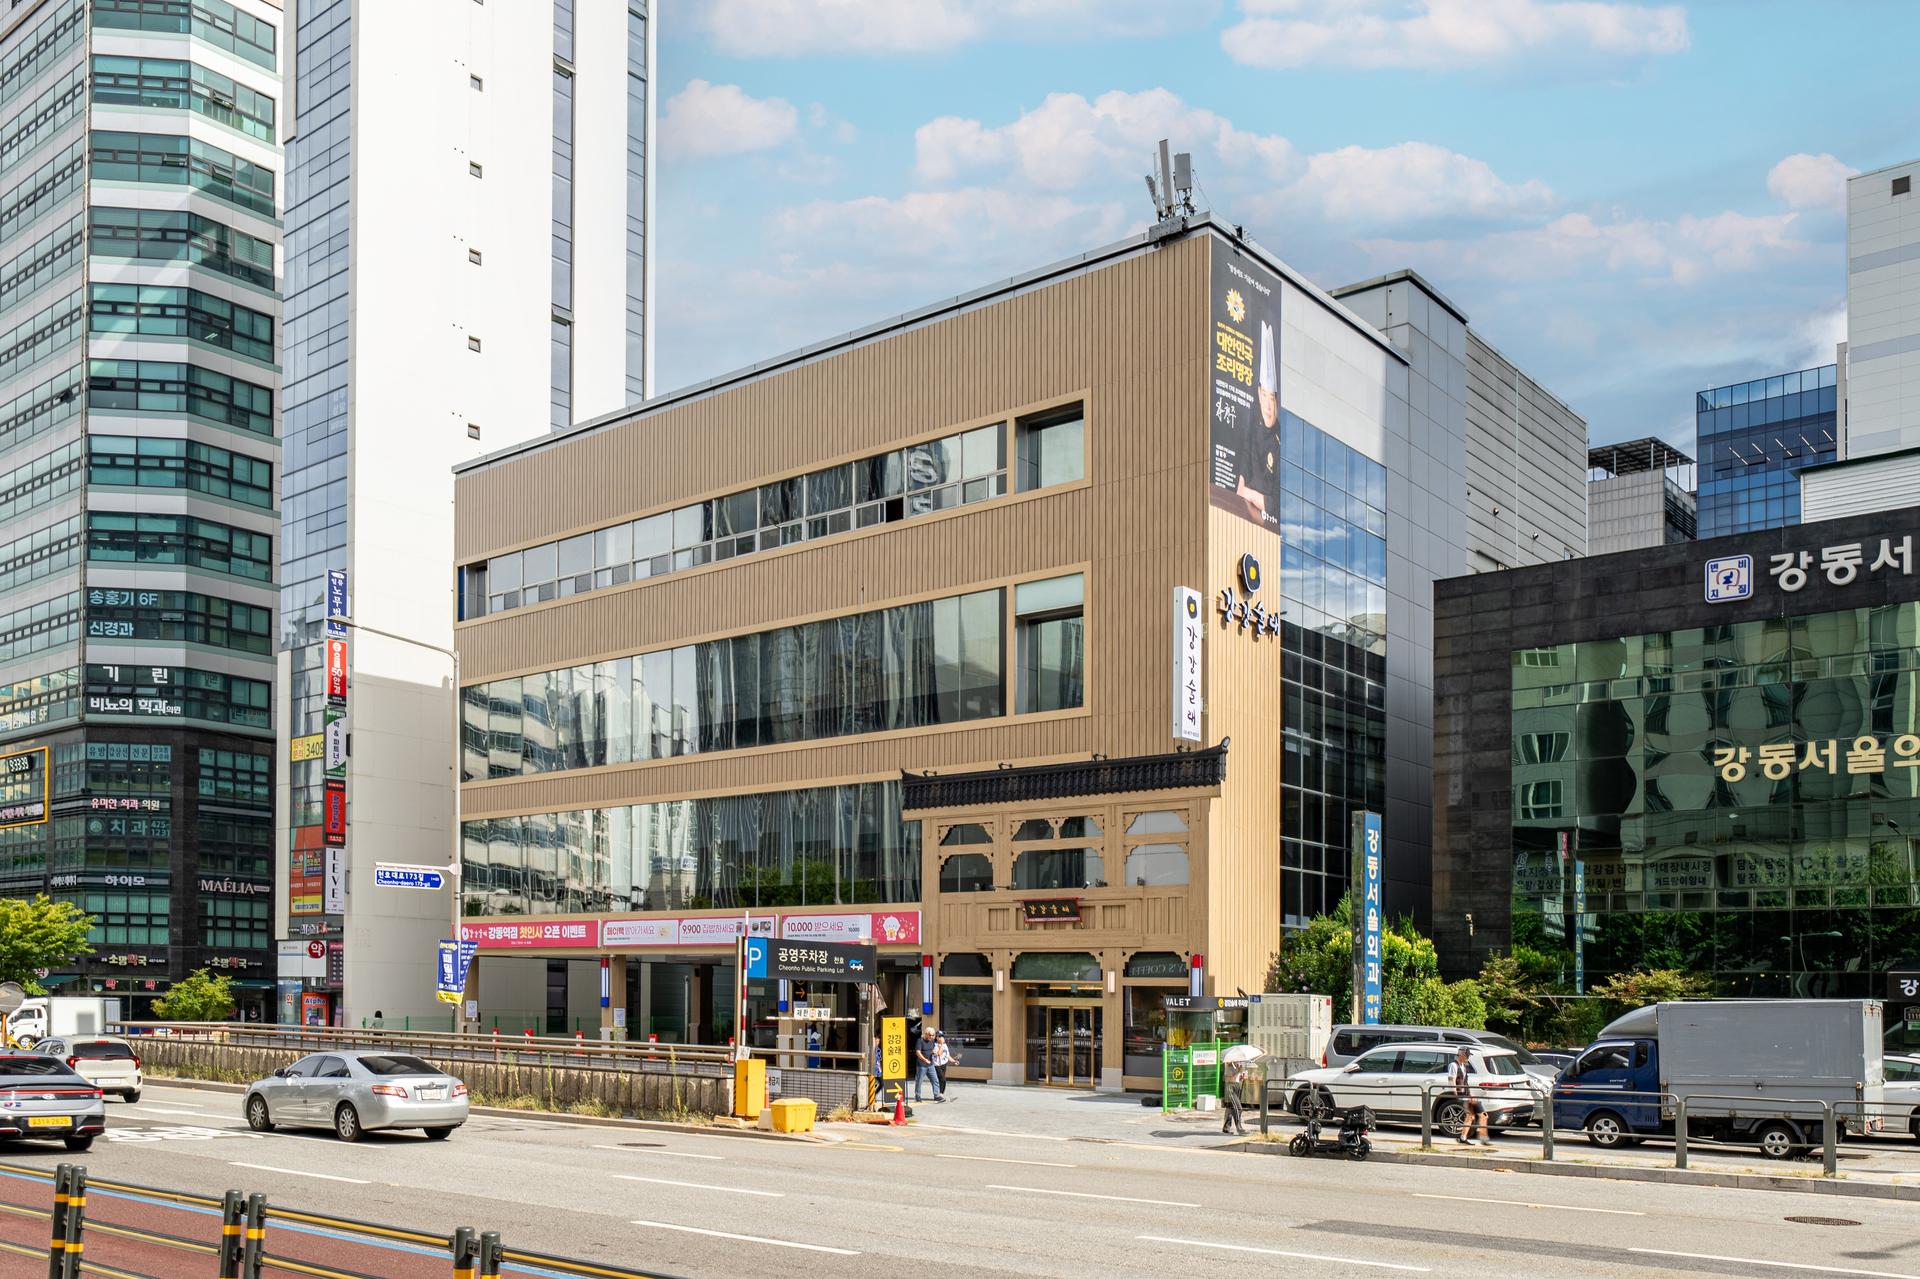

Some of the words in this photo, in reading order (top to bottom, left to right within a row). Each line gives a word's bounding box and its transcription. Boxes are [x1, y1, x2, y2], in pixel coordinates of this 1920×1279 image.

[1216, 331, 1254, 365] 대한민국
[1216, 352, 1253, 387] 조리명장
[1769, 535, 1913, 592] 강동서
[89, 590, 134, 606] 송홍기
[139, 592, 158, 606] 6F
[1221, 587, 1279, 636] 강강술래
[89, 621, 134, 637] 신경과
[1186, 625, 1197, 726] 강강술래
[89, 746, 106, 757] 유방
[90, 798, 117, 809] 유미안
[120, 798, 139, 809] 외과
[141, 799, 160, 811] 의원
[151, 829, 170, 837] 1231
[104, 875, 146, 887] 하이모
[331, 850, 340, 899] LEVE
[377, 871, 424, 882] 천호대로173길
[200, 877, 255, 894] MAÉLIA
[1367, 828, 1379, 986] 강동서울외과
[488, 926, 518, 940] 강동역점
[519, 926, 543, 939] 첫인사
[544, 925, 560, 939] 오픈
[561, 925, 587, 938] 이벤트
[682, 924, 701, 934] 9,900
[787, 921, 813, 932] 10,000
[814, 921, 844, 932] 받으세요
[311, 943, 323, 957] 약
[749, 947, 762, 969] P
[778, 947, 828, 964] 공영주차장
[833, 956, 844, 965] 천호
[778, 964, 801, 972] Cheonho
[801, 965, 816, 973] Public
[817, 966, 835, 974] Parking
[1900, 979, 1919, 997] 강
[304, 996, 326, 1005] Alpha
[1165, 998, 1191, 1007] VALET
[887, 1034, 902, 1045] 강강
[888, 1045, 902, 1056] 술래
